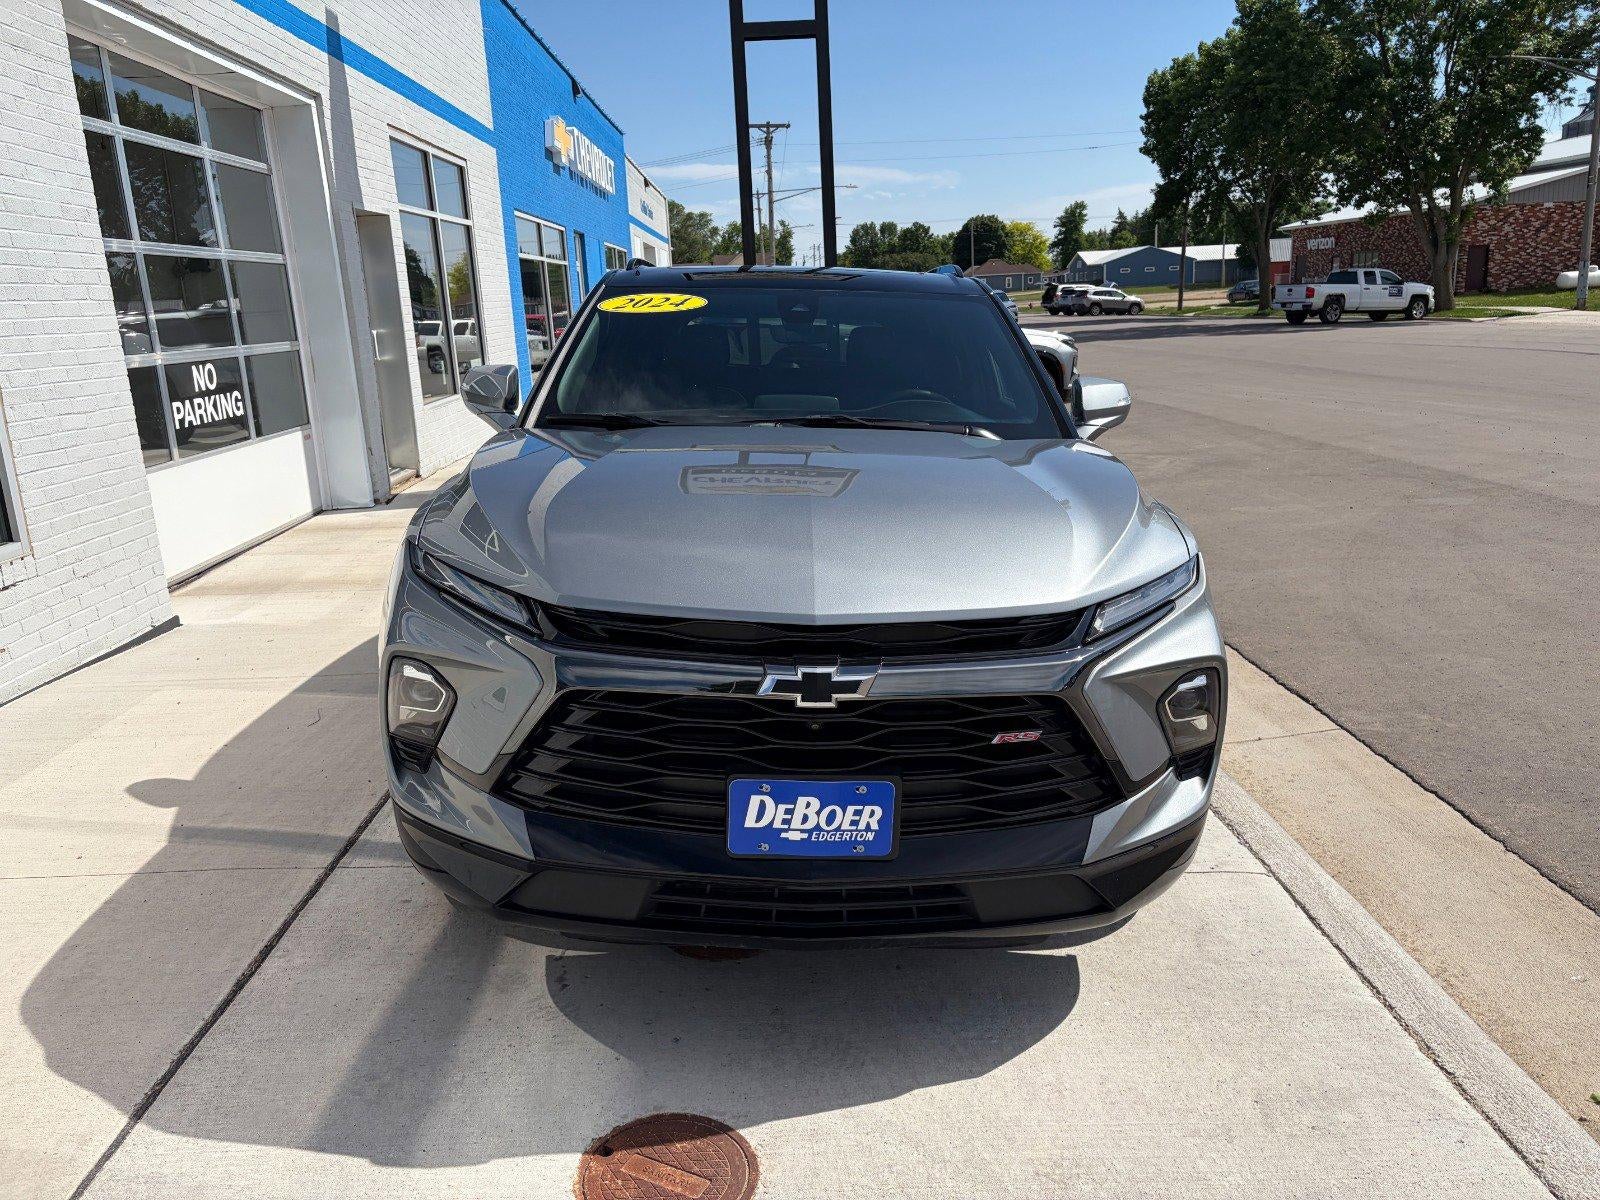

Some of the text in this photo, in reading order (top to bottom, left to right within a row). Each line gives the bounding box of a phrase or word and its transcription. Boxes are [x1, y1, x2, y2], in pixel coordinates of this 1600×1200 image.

[567, 126, 615, 195] CHEVROLET
[1306, 235, 1335, 250] verizon
[611, 296, 691, 310] 2024
[191, 363, 217, 392] NO
[172, 390, 244, 429] PARKING
[990, 730, 1043, 744] RS
[811, 830, 875, 842] EDGERTON
